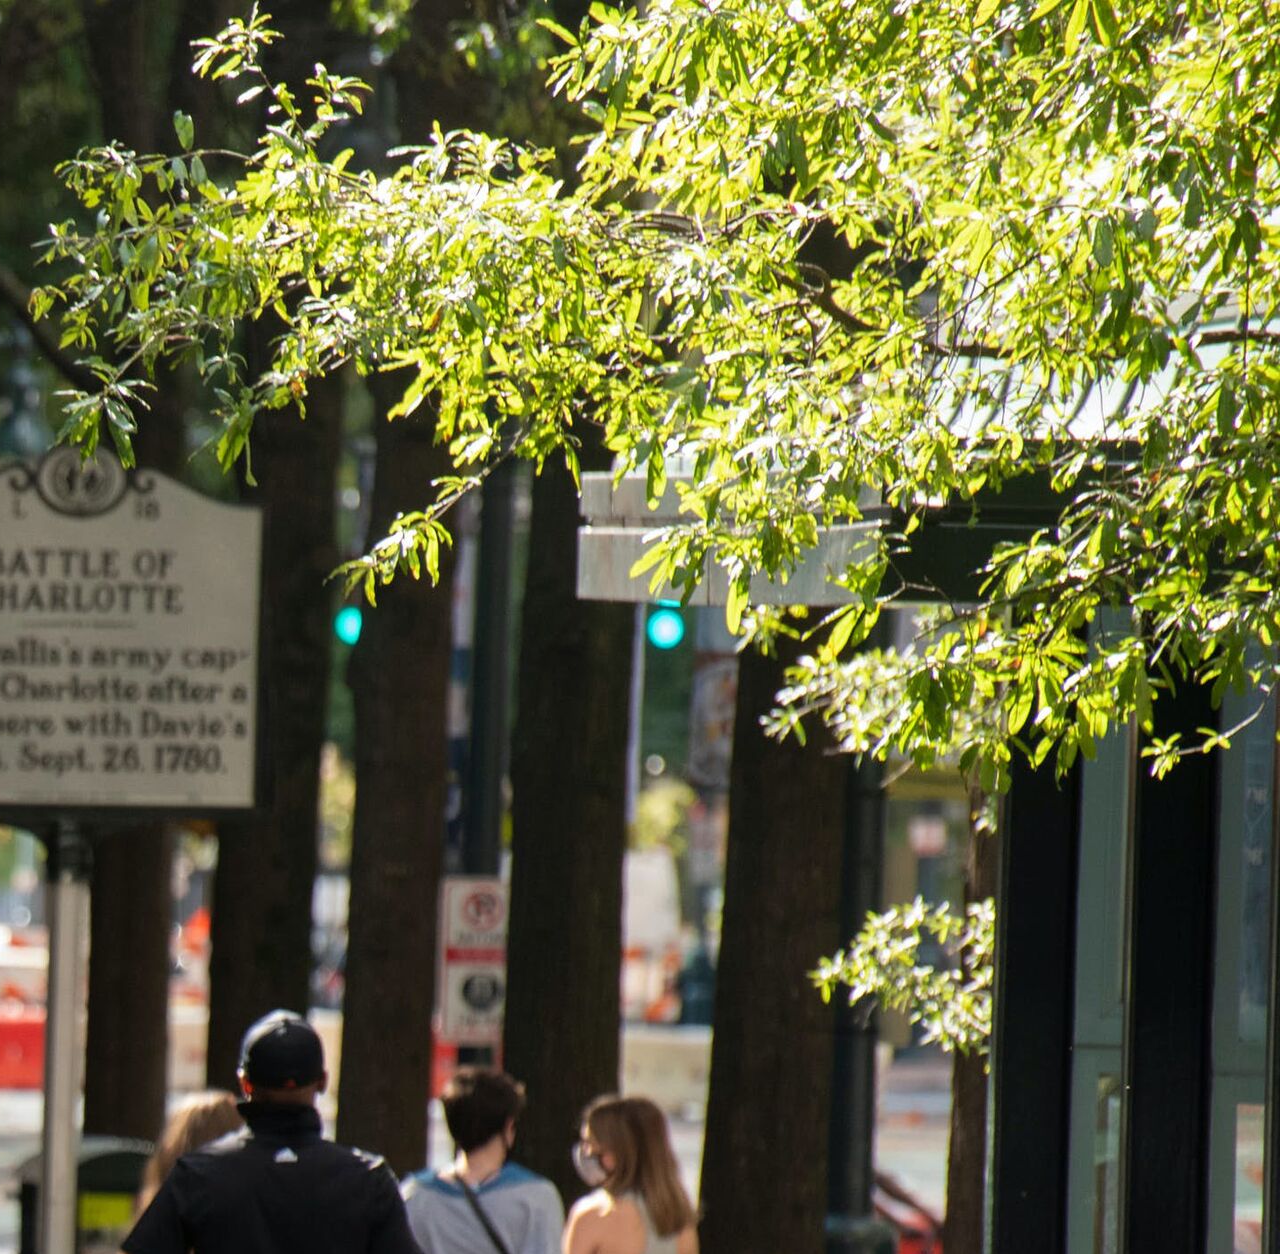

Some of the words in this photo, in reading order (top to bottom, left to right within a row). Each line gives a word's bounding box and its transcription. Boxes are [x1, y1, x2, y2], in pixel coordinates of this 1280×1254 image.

[133, 548, 178, 580] OF
[91, 648, 173, 674] army
[181, 648, 250, 674] cap-
[0, 673, 140, 701] Charlotte
[148, 675, 222, 702] after
[231, 684, 248, 702] a
[63, 711, 132, 736] with
[141, 709, 248, 738] Davie's
[17, 742, 94, 777] Sept.
[154, 744, 227, 773] 1780.
